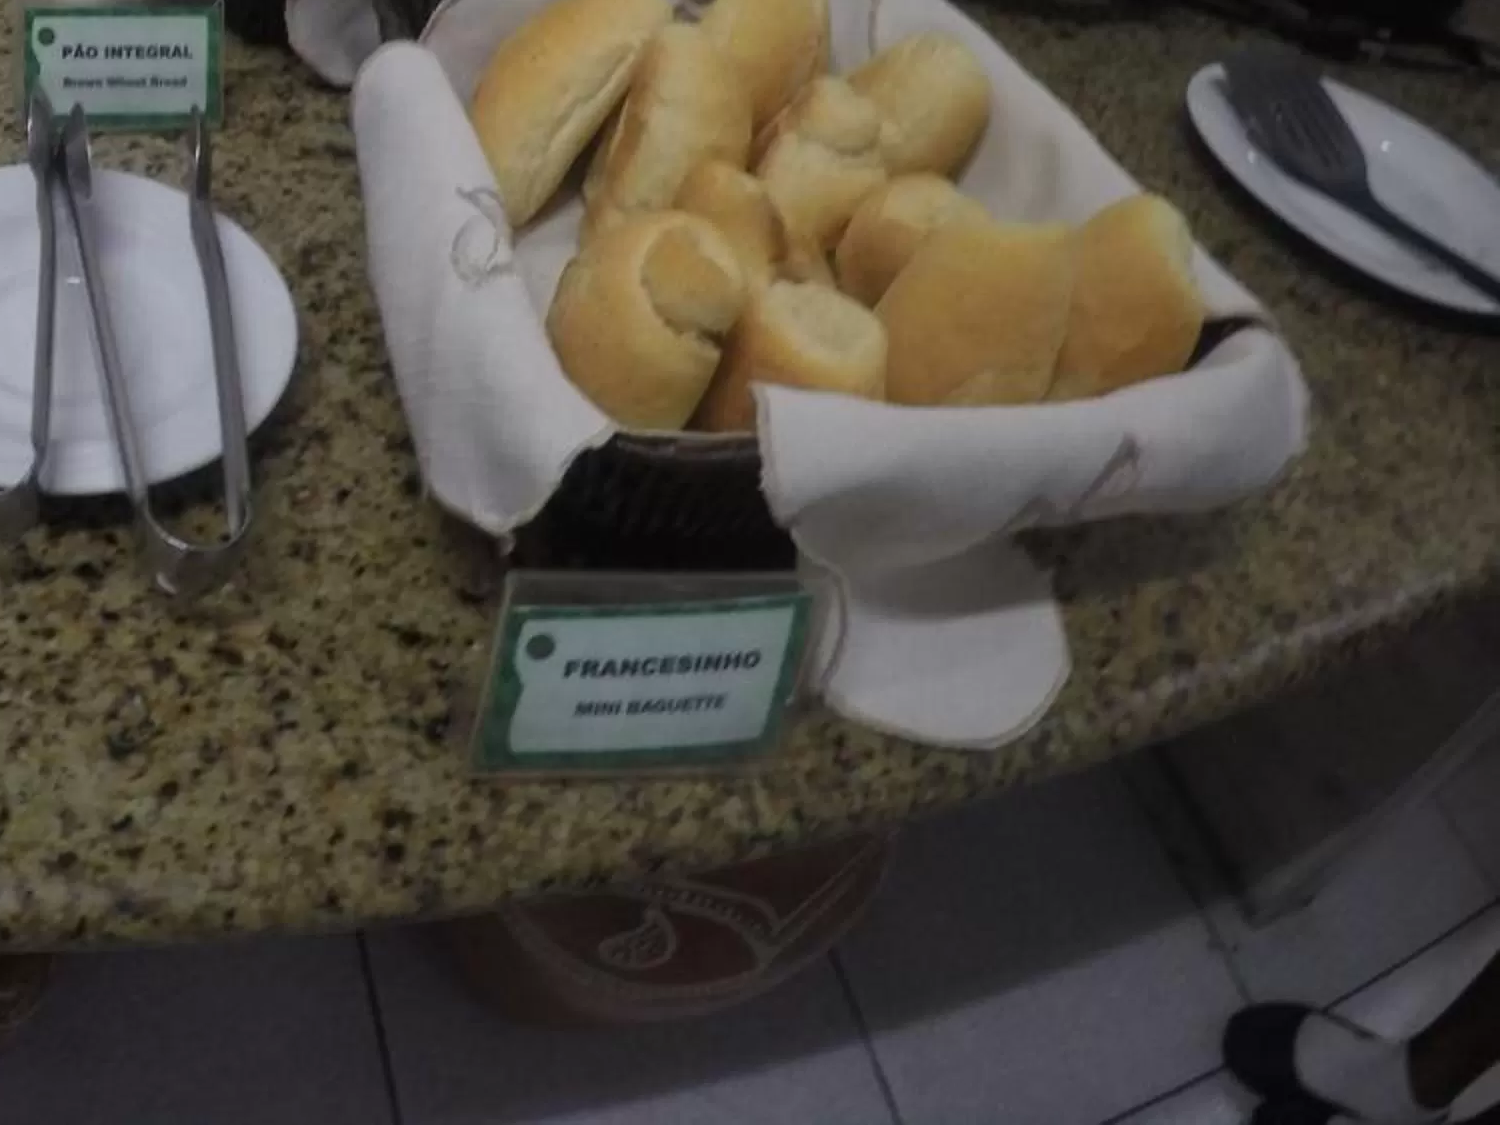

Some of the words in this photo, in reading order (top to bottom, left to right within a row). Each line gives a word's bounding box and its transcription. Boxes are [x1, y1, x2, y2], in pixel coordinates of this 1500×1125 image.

[61, 42, 99, 60] PÃO
[103, 43, 193, 60] INTEGRAL
[562, 649, 762, 679] FRANCESINHO
[572, 700, 622, 718] MINI
[625, 692, 729, 715] BAGUETTE
